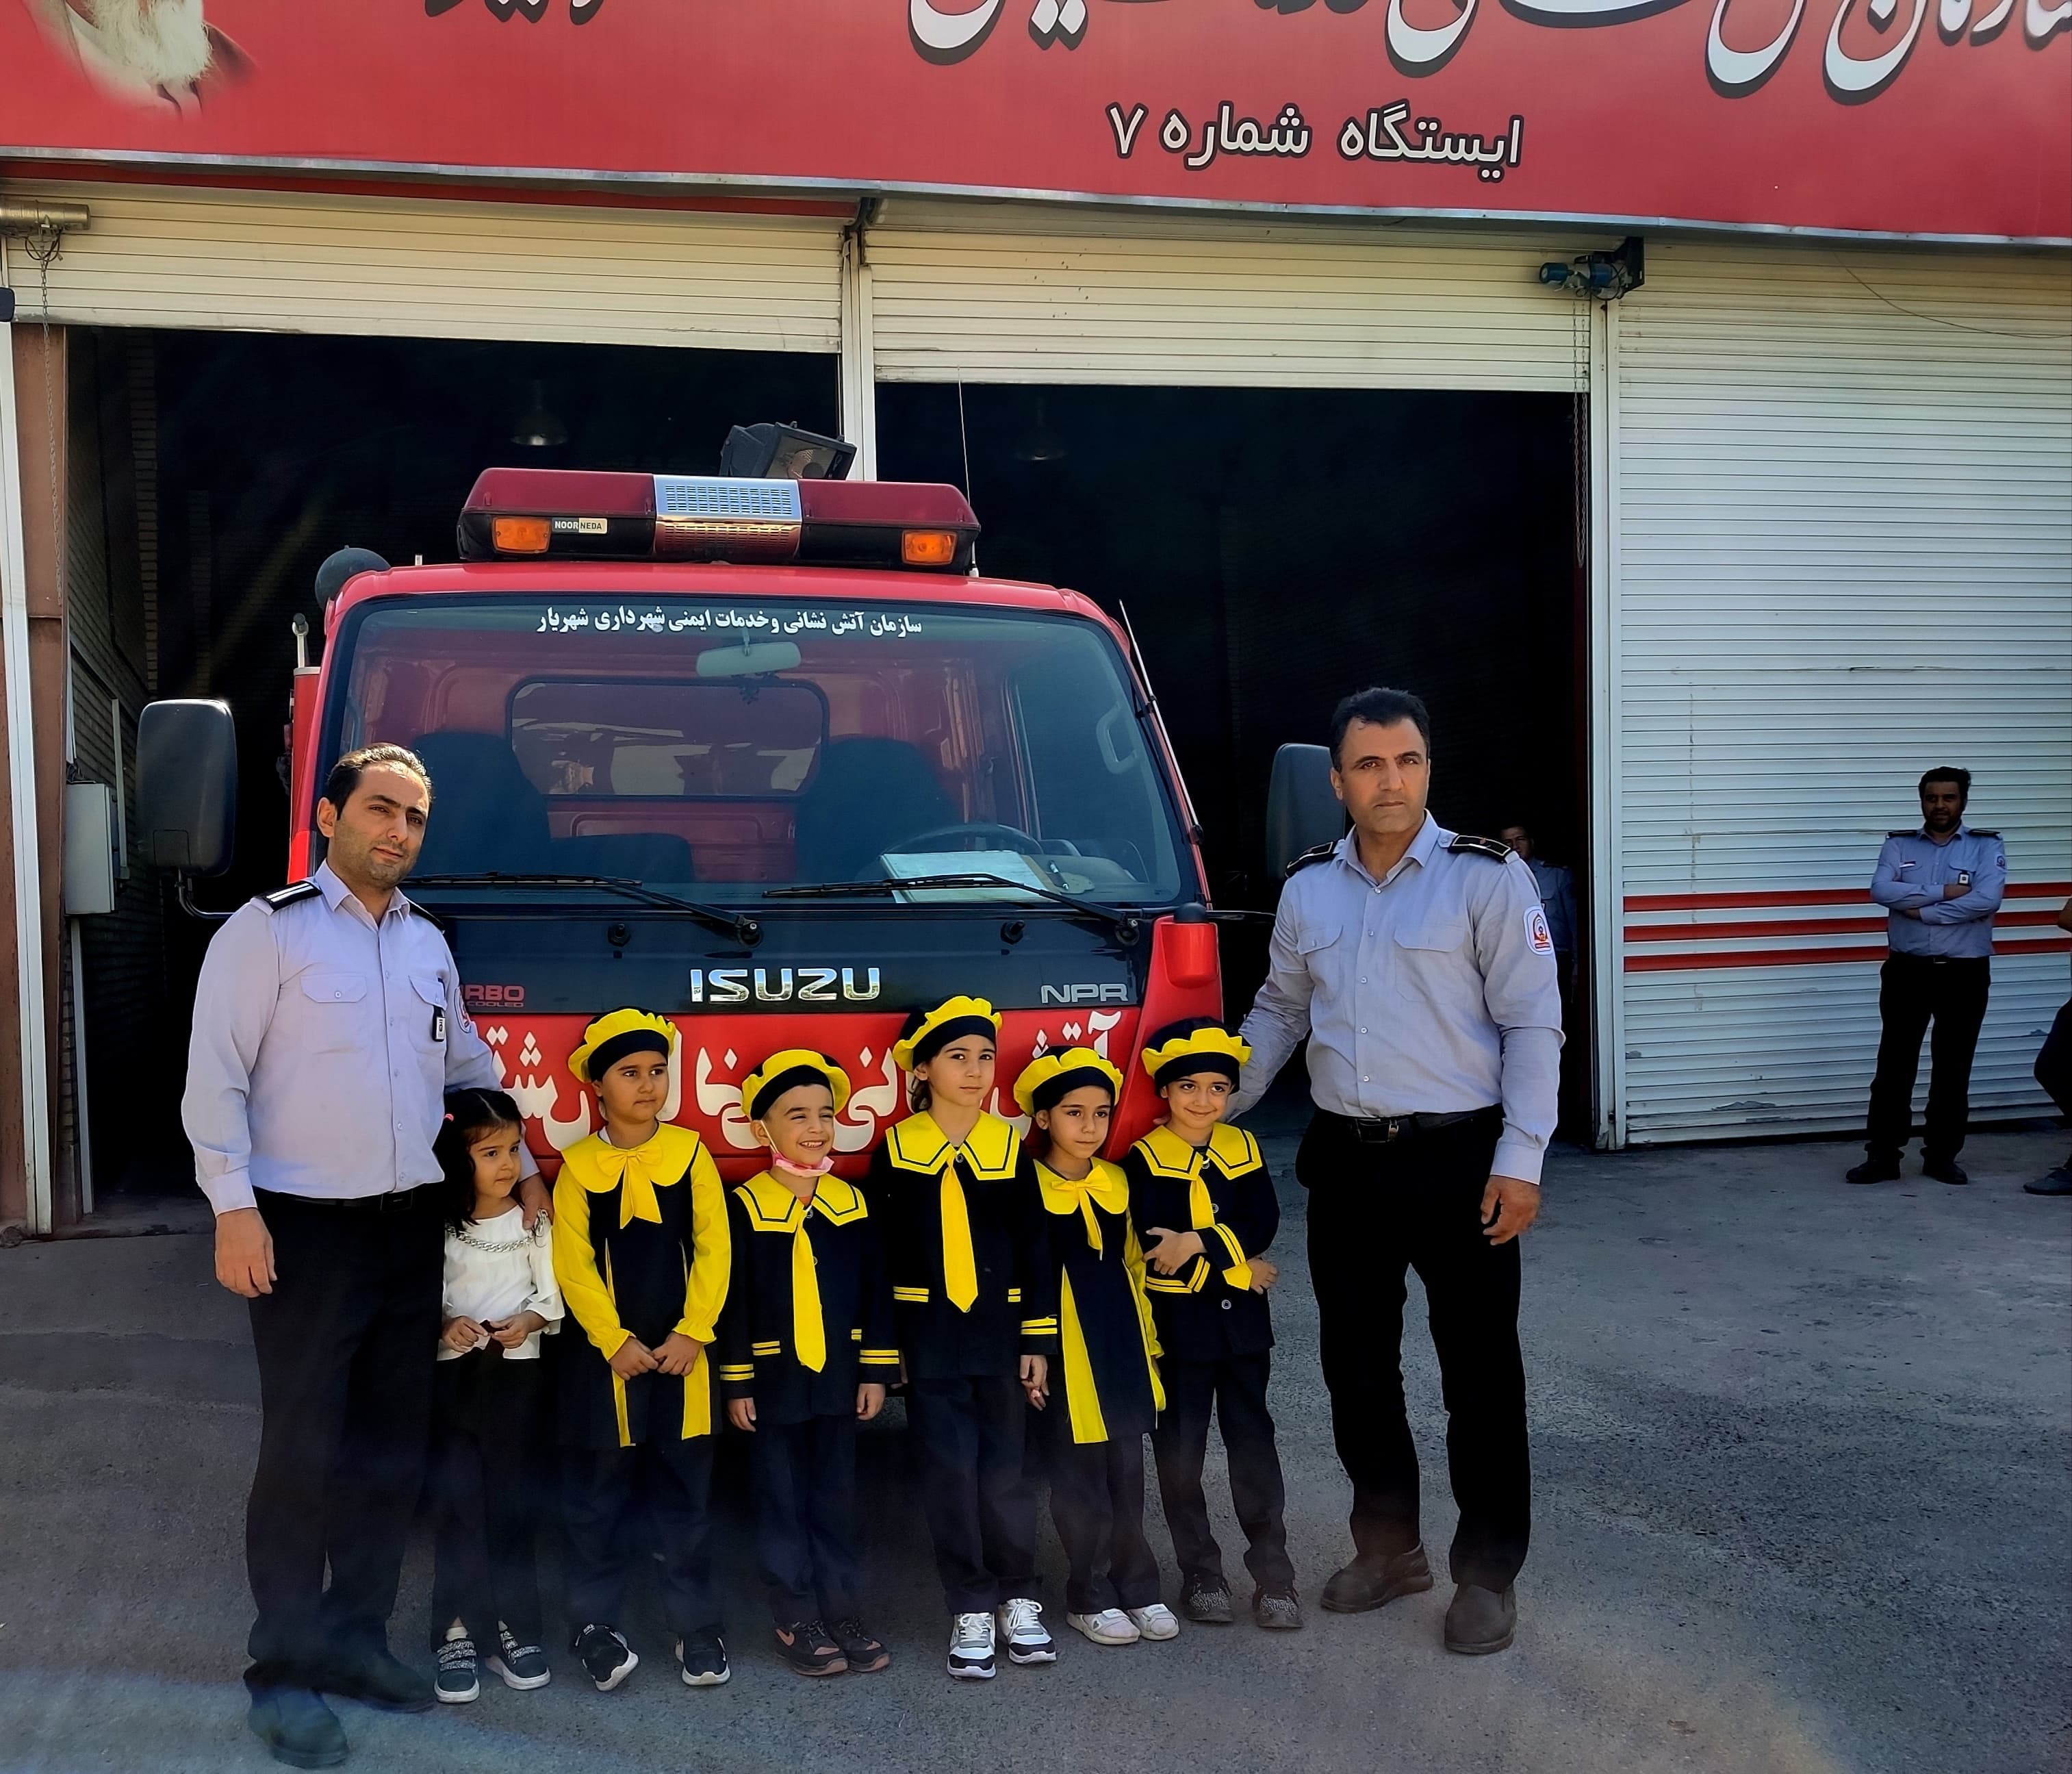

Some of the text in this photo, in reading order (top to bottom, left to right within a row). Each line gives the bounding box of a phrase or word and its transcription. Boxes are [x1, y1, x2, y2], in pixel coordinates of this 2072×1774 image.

[1109, 103, 1521, 179] ایستگاه شماره ۷
[554, 521, 578, 529] NOOR
[536, 607, 589, 633] شهریار
[593, 605, 665, 631] شهرداری
[668, 609, 711, 631] ایمنی
[783, 611, 827, 633] نشانی
[832, 611, 865, 635] آتش
[870, 614, 922, 637] سازمان
[461, 984, 525, 1002] RBO
[689, 967, 881, 1003] ISUZU
[1040, 983, 1129, 1004] NPR
